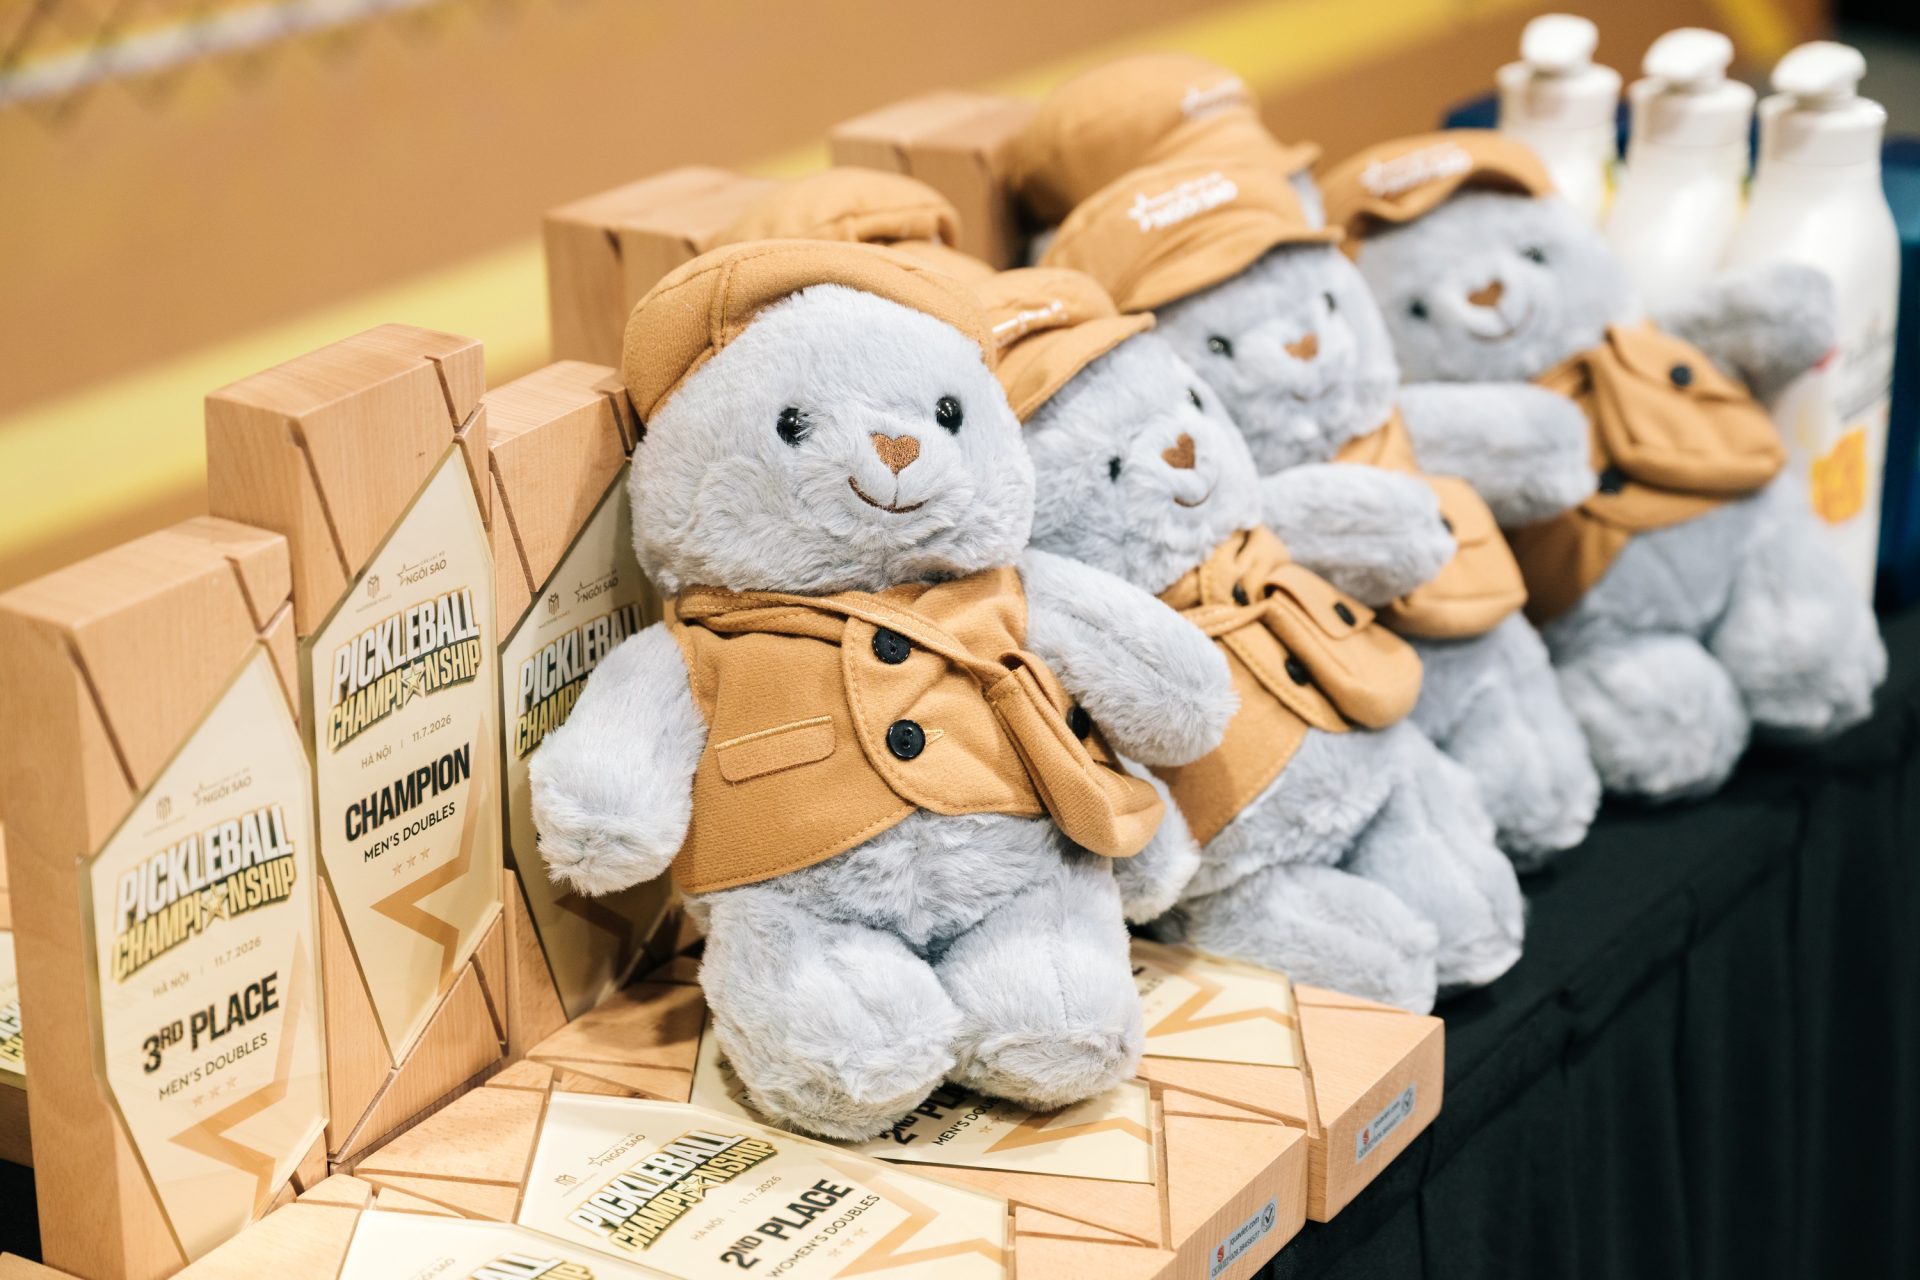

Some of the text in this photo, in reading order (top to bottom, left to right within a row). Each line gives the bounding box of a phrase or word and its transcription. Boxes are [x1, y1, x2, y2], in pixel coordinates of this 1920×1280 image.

[429, 559, 447, 576] SAO
[331, 587, 481, 705] PICKLEBALL
[411, 713, 453, 744] 11.7.2026
[344, 741, 471, 843] CHAMPION
[115, 804, 295, 936] PICKLEBALL
[362, 800, 457, 864] MEN'S DOUBLES
[213, 935, 263, 968] 11.7.2026
[142, 969, 280, 1074] 3RD PLACE
[158, 1030, 270, 1101] MEN'S DOUBLES
[931, 1119, 971, 1146] MEN'S
[567, 1130, 751, 1238] PICKLEBALL
[738, 1174, 783, 1205] 11.7.2026
[719, 1177, 856, 1271] 2ND PLACE
[765, 1193, 882, 1279] WOMEN'S DOUBLES
